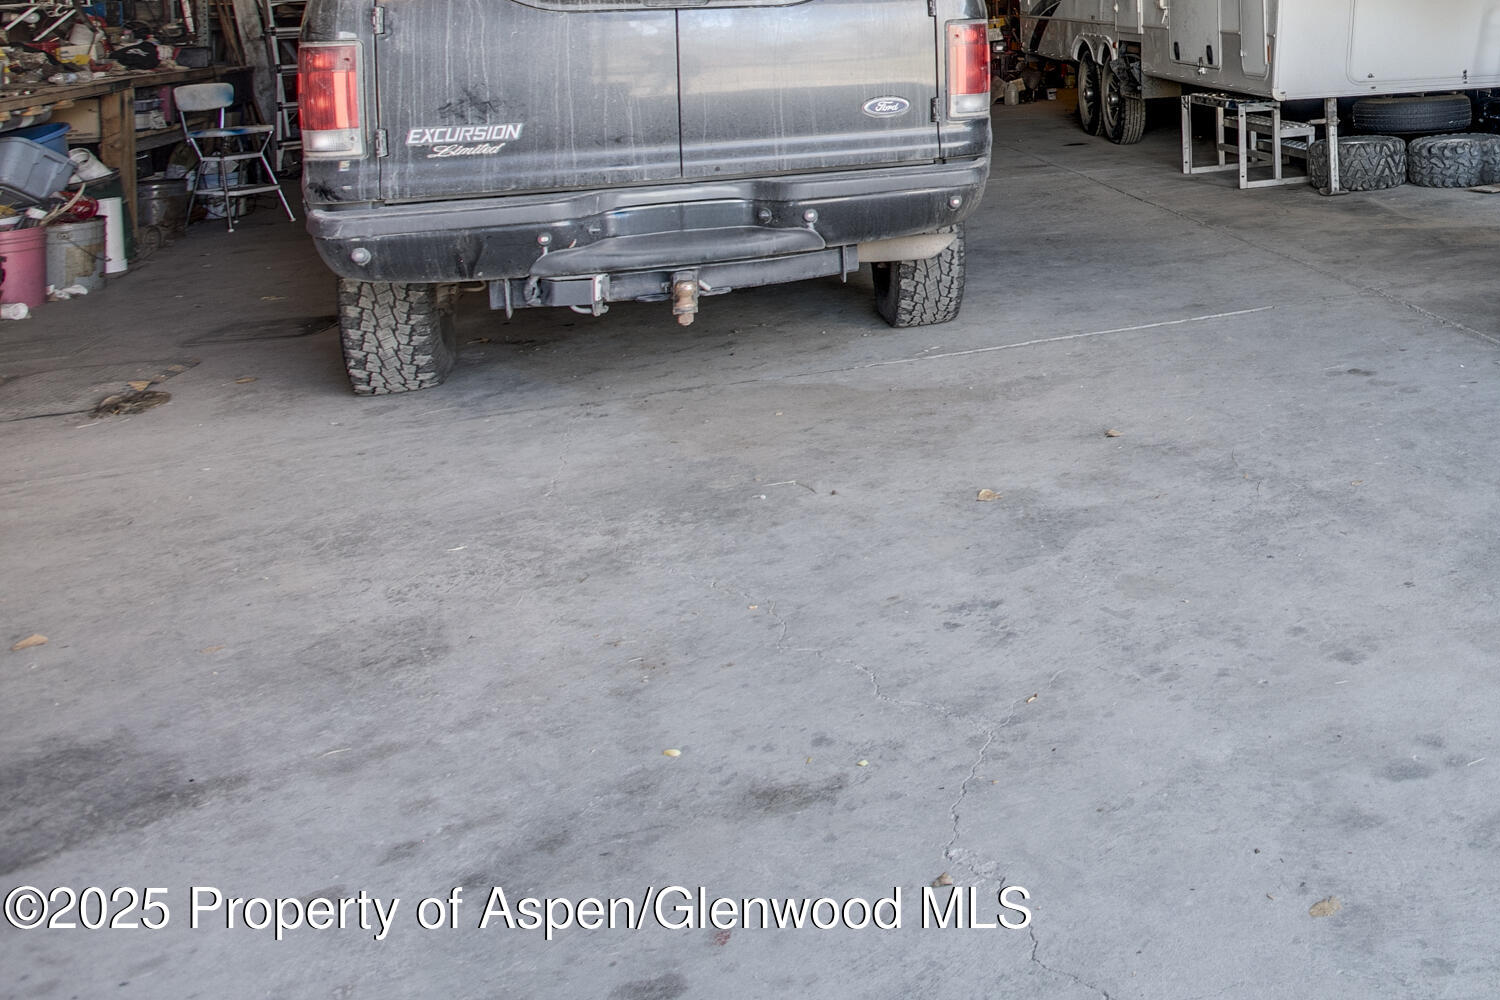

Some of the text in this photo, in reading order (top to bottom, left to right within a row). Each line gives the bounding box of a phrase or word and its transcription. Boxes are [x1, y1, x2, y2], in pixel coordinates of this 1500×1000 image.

[875, 101, 900, 112] Ford
[406, 122, 525, 146] EXCURSION
[427, 142, 506, 159] Limited
